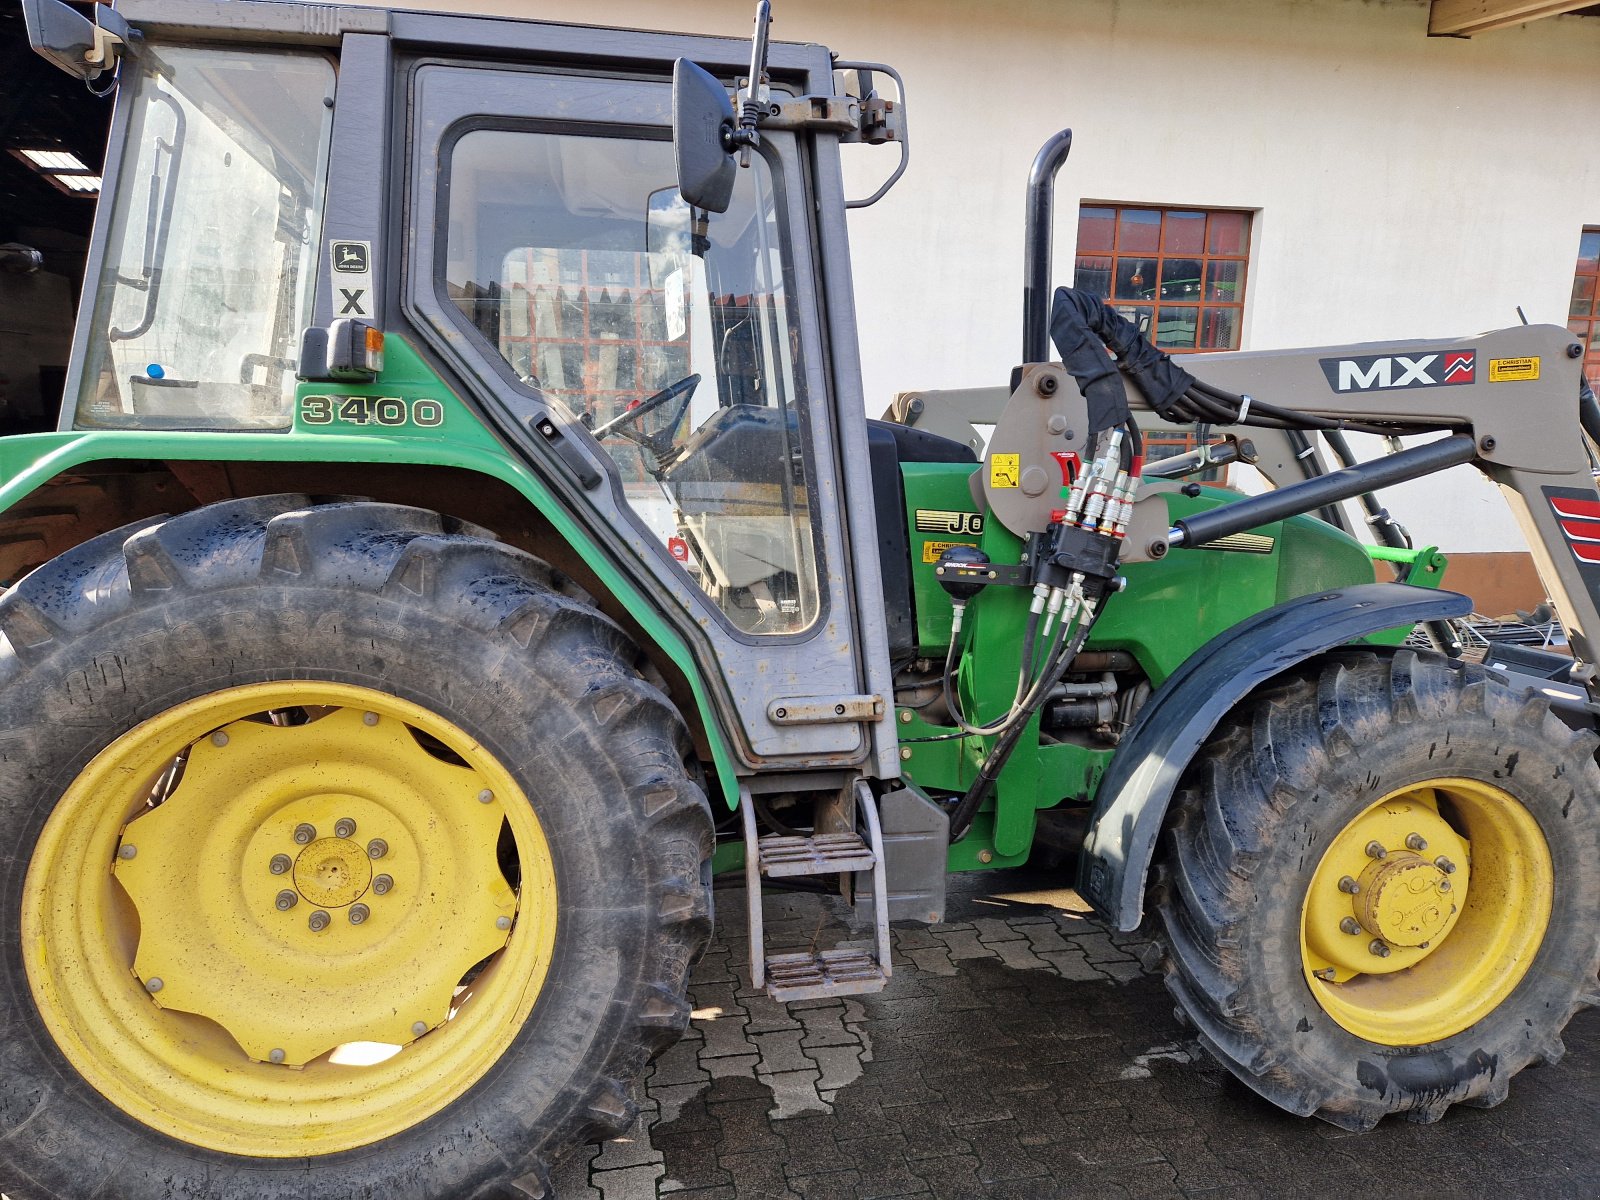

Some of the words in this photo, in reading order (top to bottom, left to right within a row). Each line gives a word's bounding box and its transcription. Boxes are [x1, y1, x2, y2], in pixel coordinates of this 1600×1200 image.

[339, 288, 366, 315] X
[1339, 354, 1439, 391] MX
[300, 395, 444, 428] 3400
